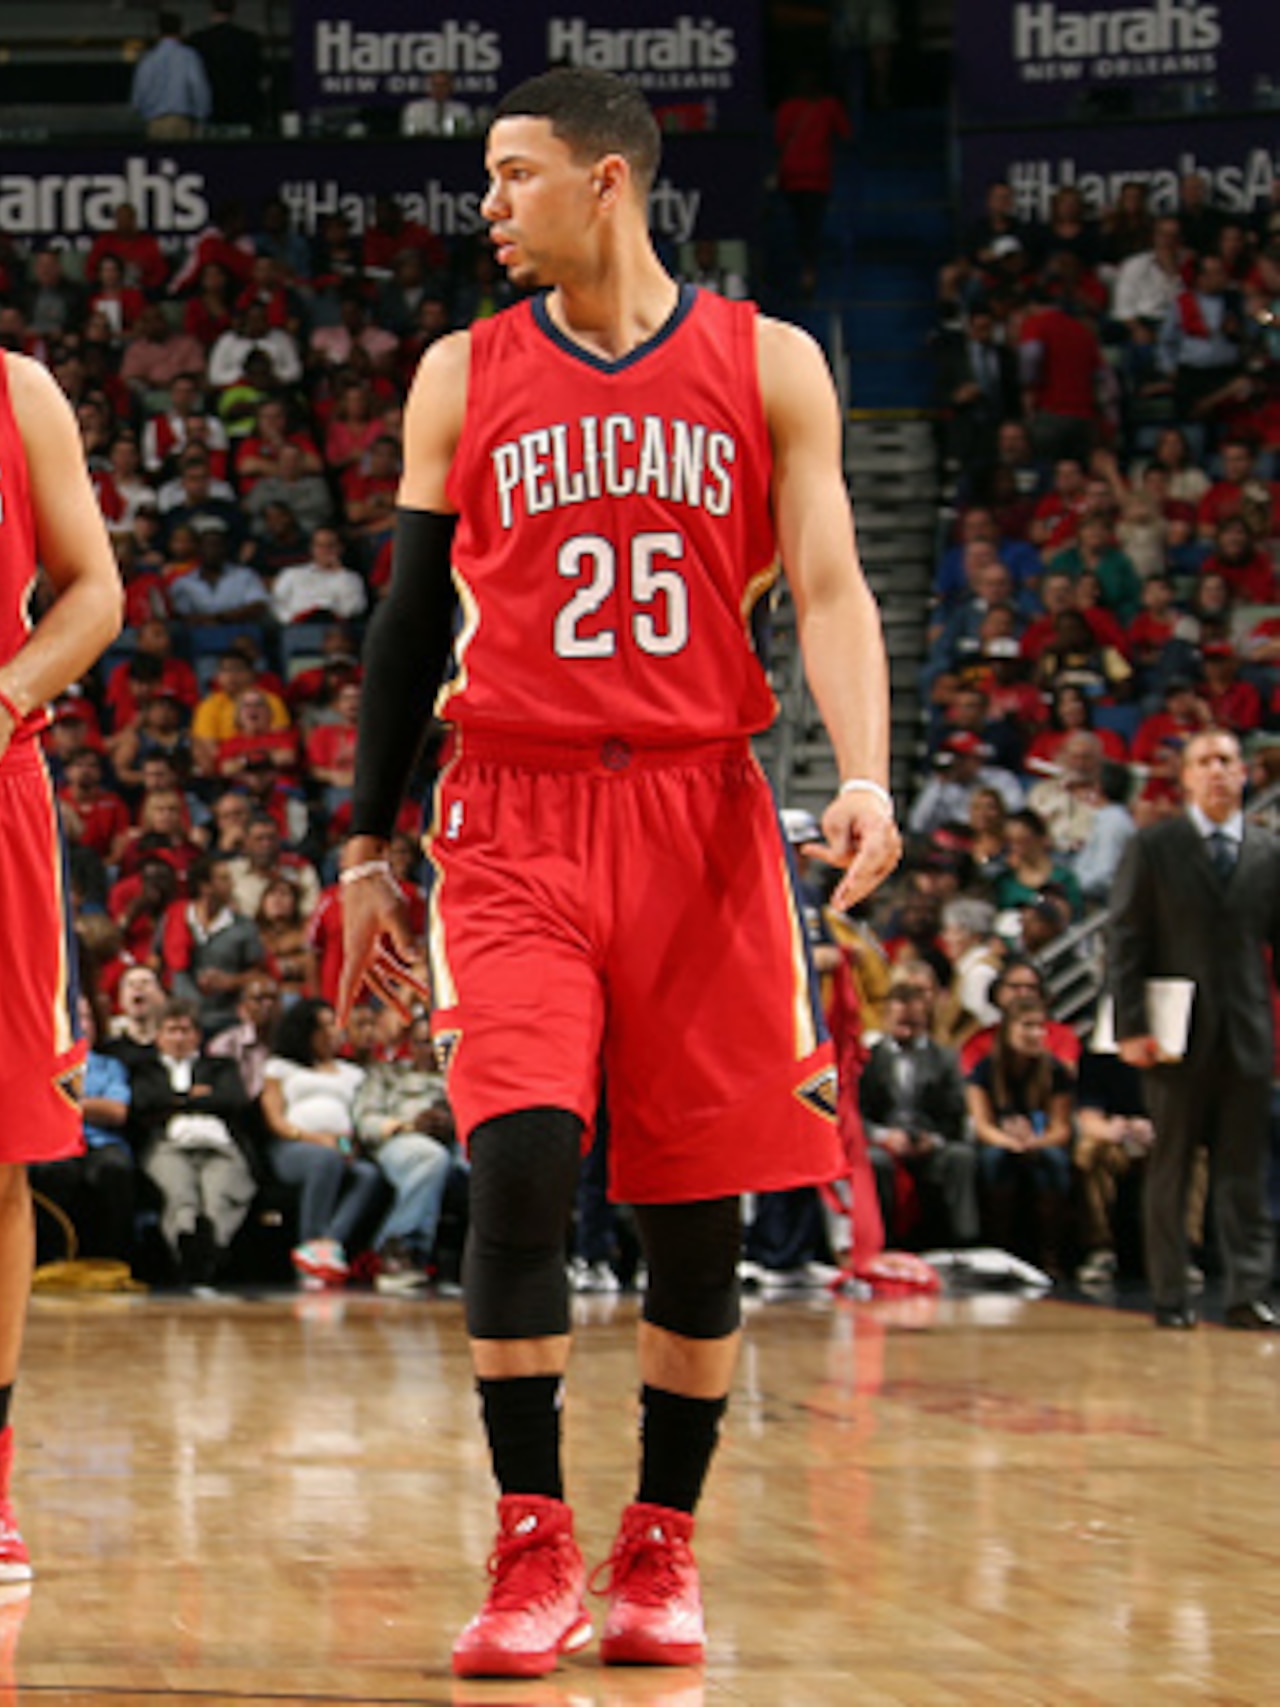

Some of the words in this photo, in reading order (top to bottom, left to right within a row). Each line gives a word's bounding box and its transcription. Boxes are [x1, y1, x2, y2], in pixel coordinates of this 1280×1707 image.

[315, 19, 503, 74] Harrah's
[548, 15, 737, 72] Harrah's
[1021, 62, 1084, 83] NEW
[1090, 54, 1218, 79] ORLEANS
[321, 76, 379, 95] NEW
[384, 75, 498, 96] ORNS
[492, 413, 736, 530] PELICANS
[552, 532, 690, 659] 25
